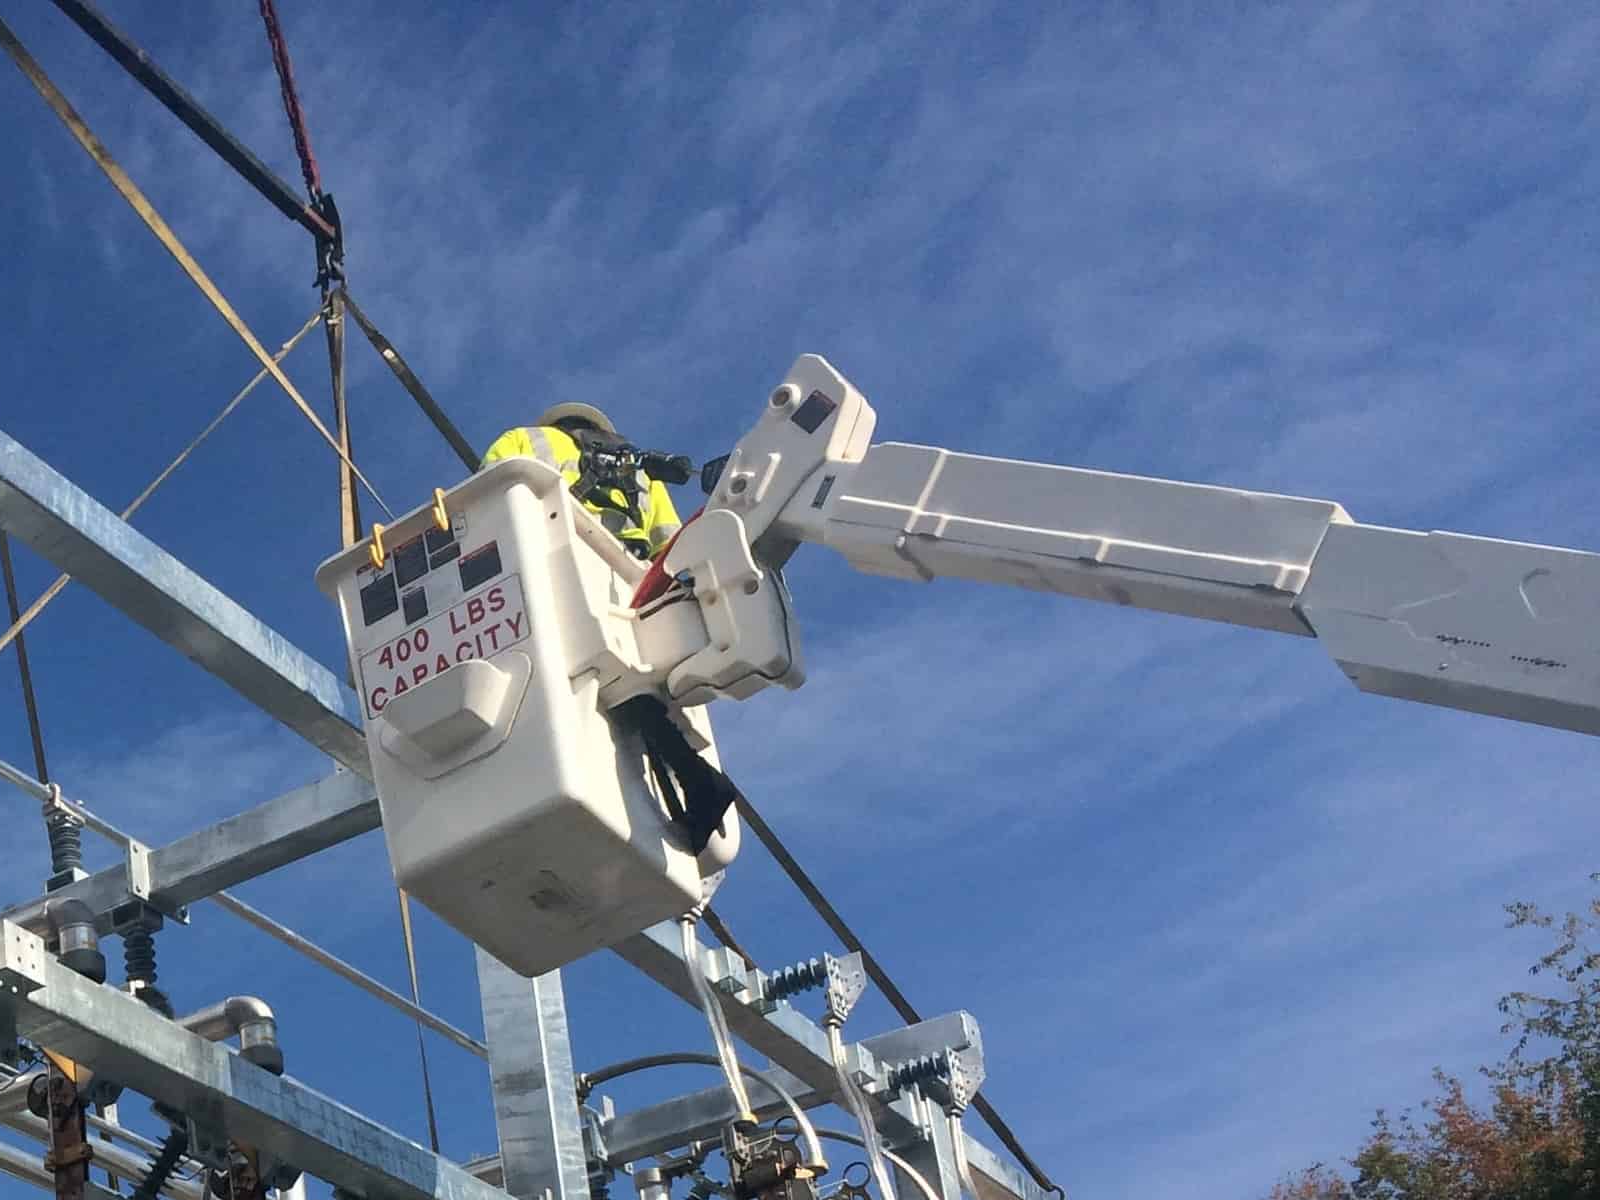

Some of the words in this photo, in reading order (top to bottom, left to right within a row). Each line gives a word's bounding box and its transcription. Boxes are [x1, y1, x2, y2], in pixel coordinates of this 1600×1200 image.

[371, 611, 522, 711] CAPACITY
[378, 628, 429, 670] 400
[449, 587, 506, 635] LBS
